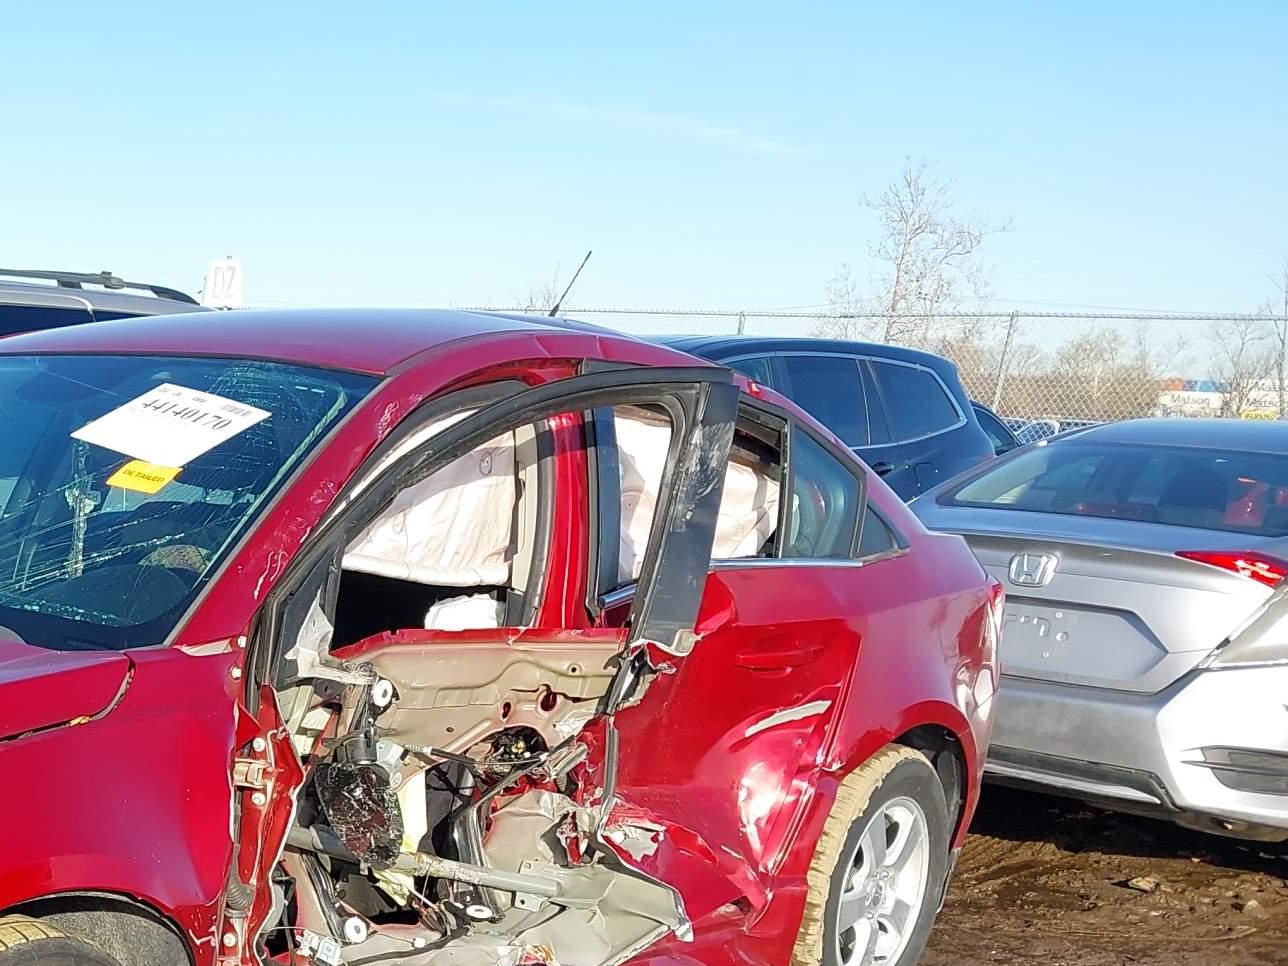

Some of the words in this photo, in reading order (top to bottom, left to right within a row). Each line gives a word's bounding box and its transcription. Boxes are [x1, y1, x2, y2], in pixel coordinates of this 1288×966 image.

[1170, 394, 1210, 406] Matson
[142, 399, 233, 430] 44140170
[122, 469, 165, 483] DETAILED
